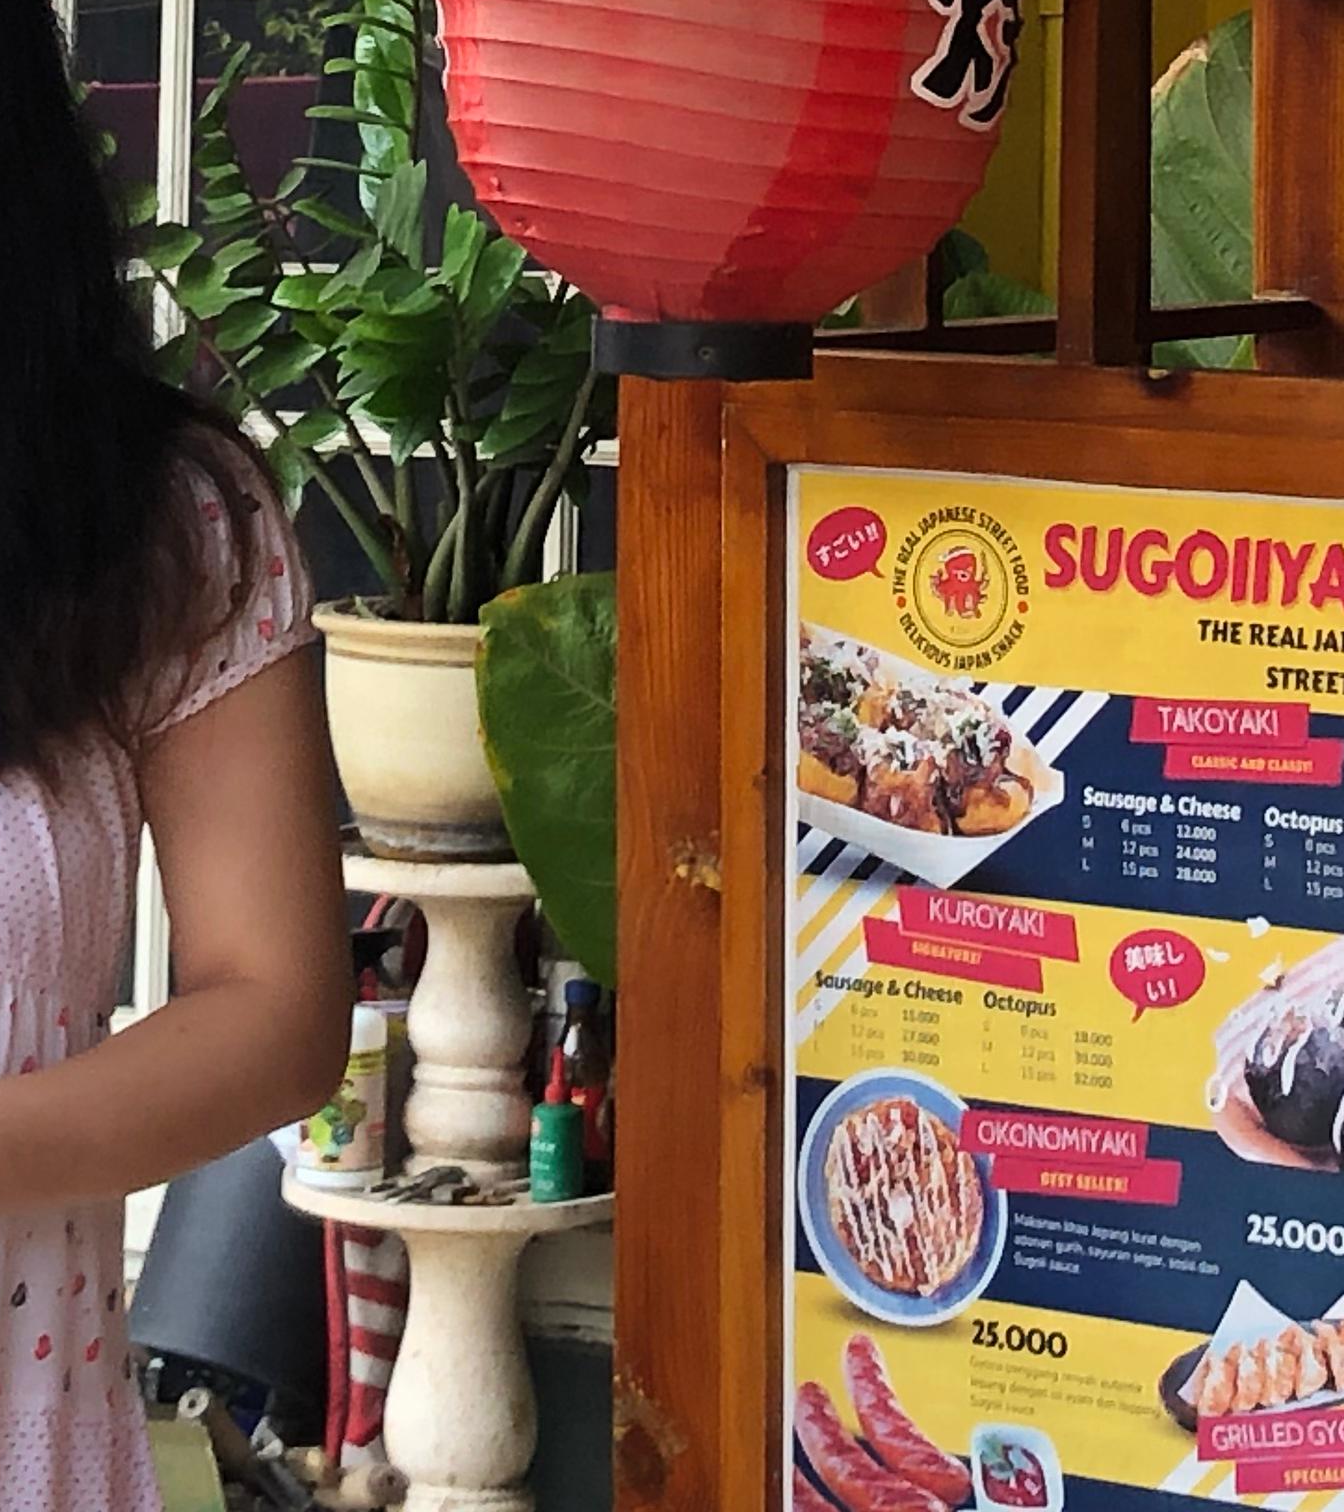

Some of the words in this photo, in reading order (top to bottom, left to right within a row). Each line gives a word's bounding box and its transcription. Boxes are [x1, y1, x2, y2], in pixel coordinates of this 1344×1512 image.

[918, 506, 977, 535] JAPANESE
[976, 511, 1019, 554] STREET
[897, 529, 921, 565] REAL
[892, 567, 907, 596] THE
[1009, 555, 1030, 596] FOOD
[899, 612, 952, 669] DELICIOUS
[954, 653, 992, 671] JAPAN
[991, 619, 1026, 660] SNACK
[1198, 619, 1243, 646] THE
[1249, 623, 1308, 651] REAL
[1157, 705, 1279, 738] TAKOYAKI
[1083, 786, 1157, 816] Sausage
[1160, 794, 1175, 813] &
[1178, 795, 1241, 821] Cheese
[1264, 806, 1344, 836] Octopus
[1264, 834, 1274, 848] S
[1316, 842, 1336, 856] pcs
[1082, 858, 1090, 871] L
[1306, 860, 1320, 874] 12
[1323, 864, 1344, 877] pcs
[1264, 877, 1273, 890] L
[929, 896, 1045, 937] KUROYAKI
[1124, 941, 1185, 972] 美味し
[815, 969, 883, 998] Sausage
[887, 980, 900, 996] &
[904, 980, 963, 1005] Cheese
[983, 991, 1057, 1018] Octopus
[977, 1120, 1137, 1157] OKONOMIYAKI
[971, 1318, 1068, 1358] 25.000
[1211, 1419, 1304, 1452] GRILLED
